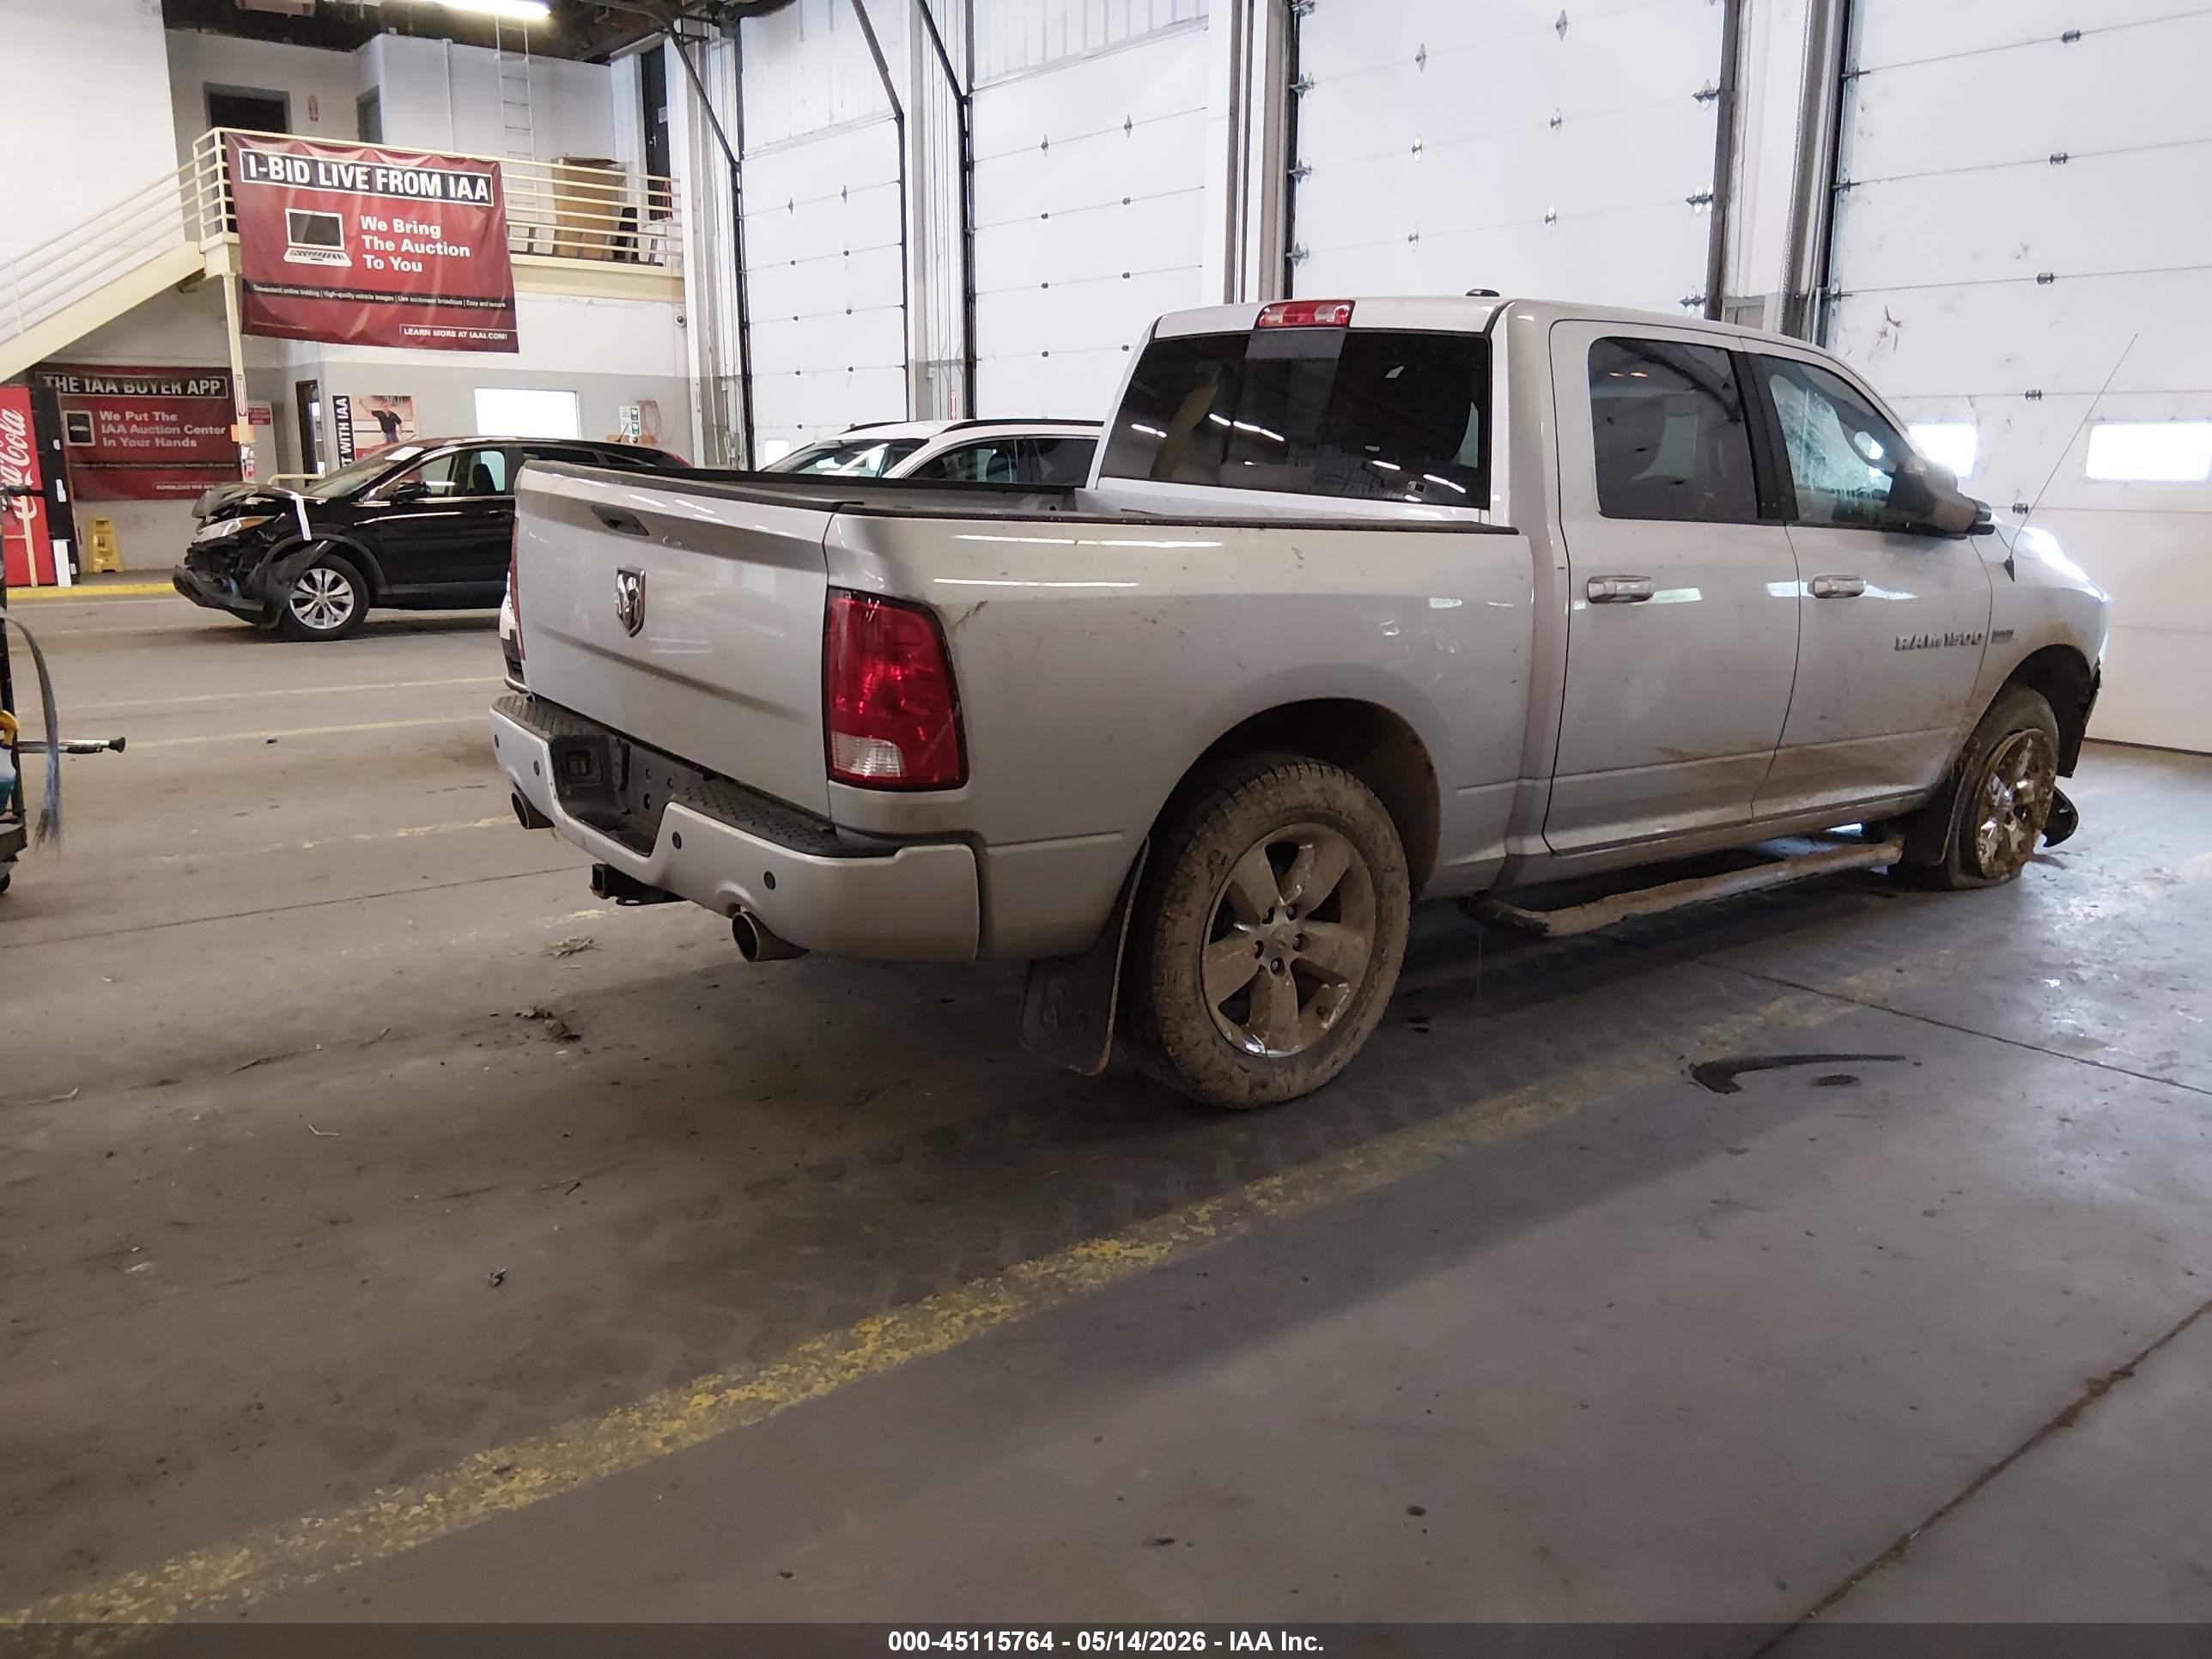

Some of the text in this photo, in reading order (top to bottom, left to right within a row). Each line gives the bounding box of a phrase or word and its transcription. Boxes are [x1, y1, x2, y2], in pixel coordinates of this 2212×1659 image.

[248, 155, 489, 201] I-BID LIVE FROM IAA
[361, 216, 441, 239] We Bring
[362, 234, 471, 257] The Auction
[362, 254, 422, 272] To You
[404, 327, 431, 336] LEARN
[433, 329, 457, 337] MORE
[42, 376, 222, 395] THE IAA BUYER APP
[99, 410, 178, 422] We Put The
[336, 398, 349, 419] IAA
[101, 424, 227, 435] IAA Auction Center
[338, 422, 352, 454] WITH
[103, 437, 198, 447] In Your Hands
